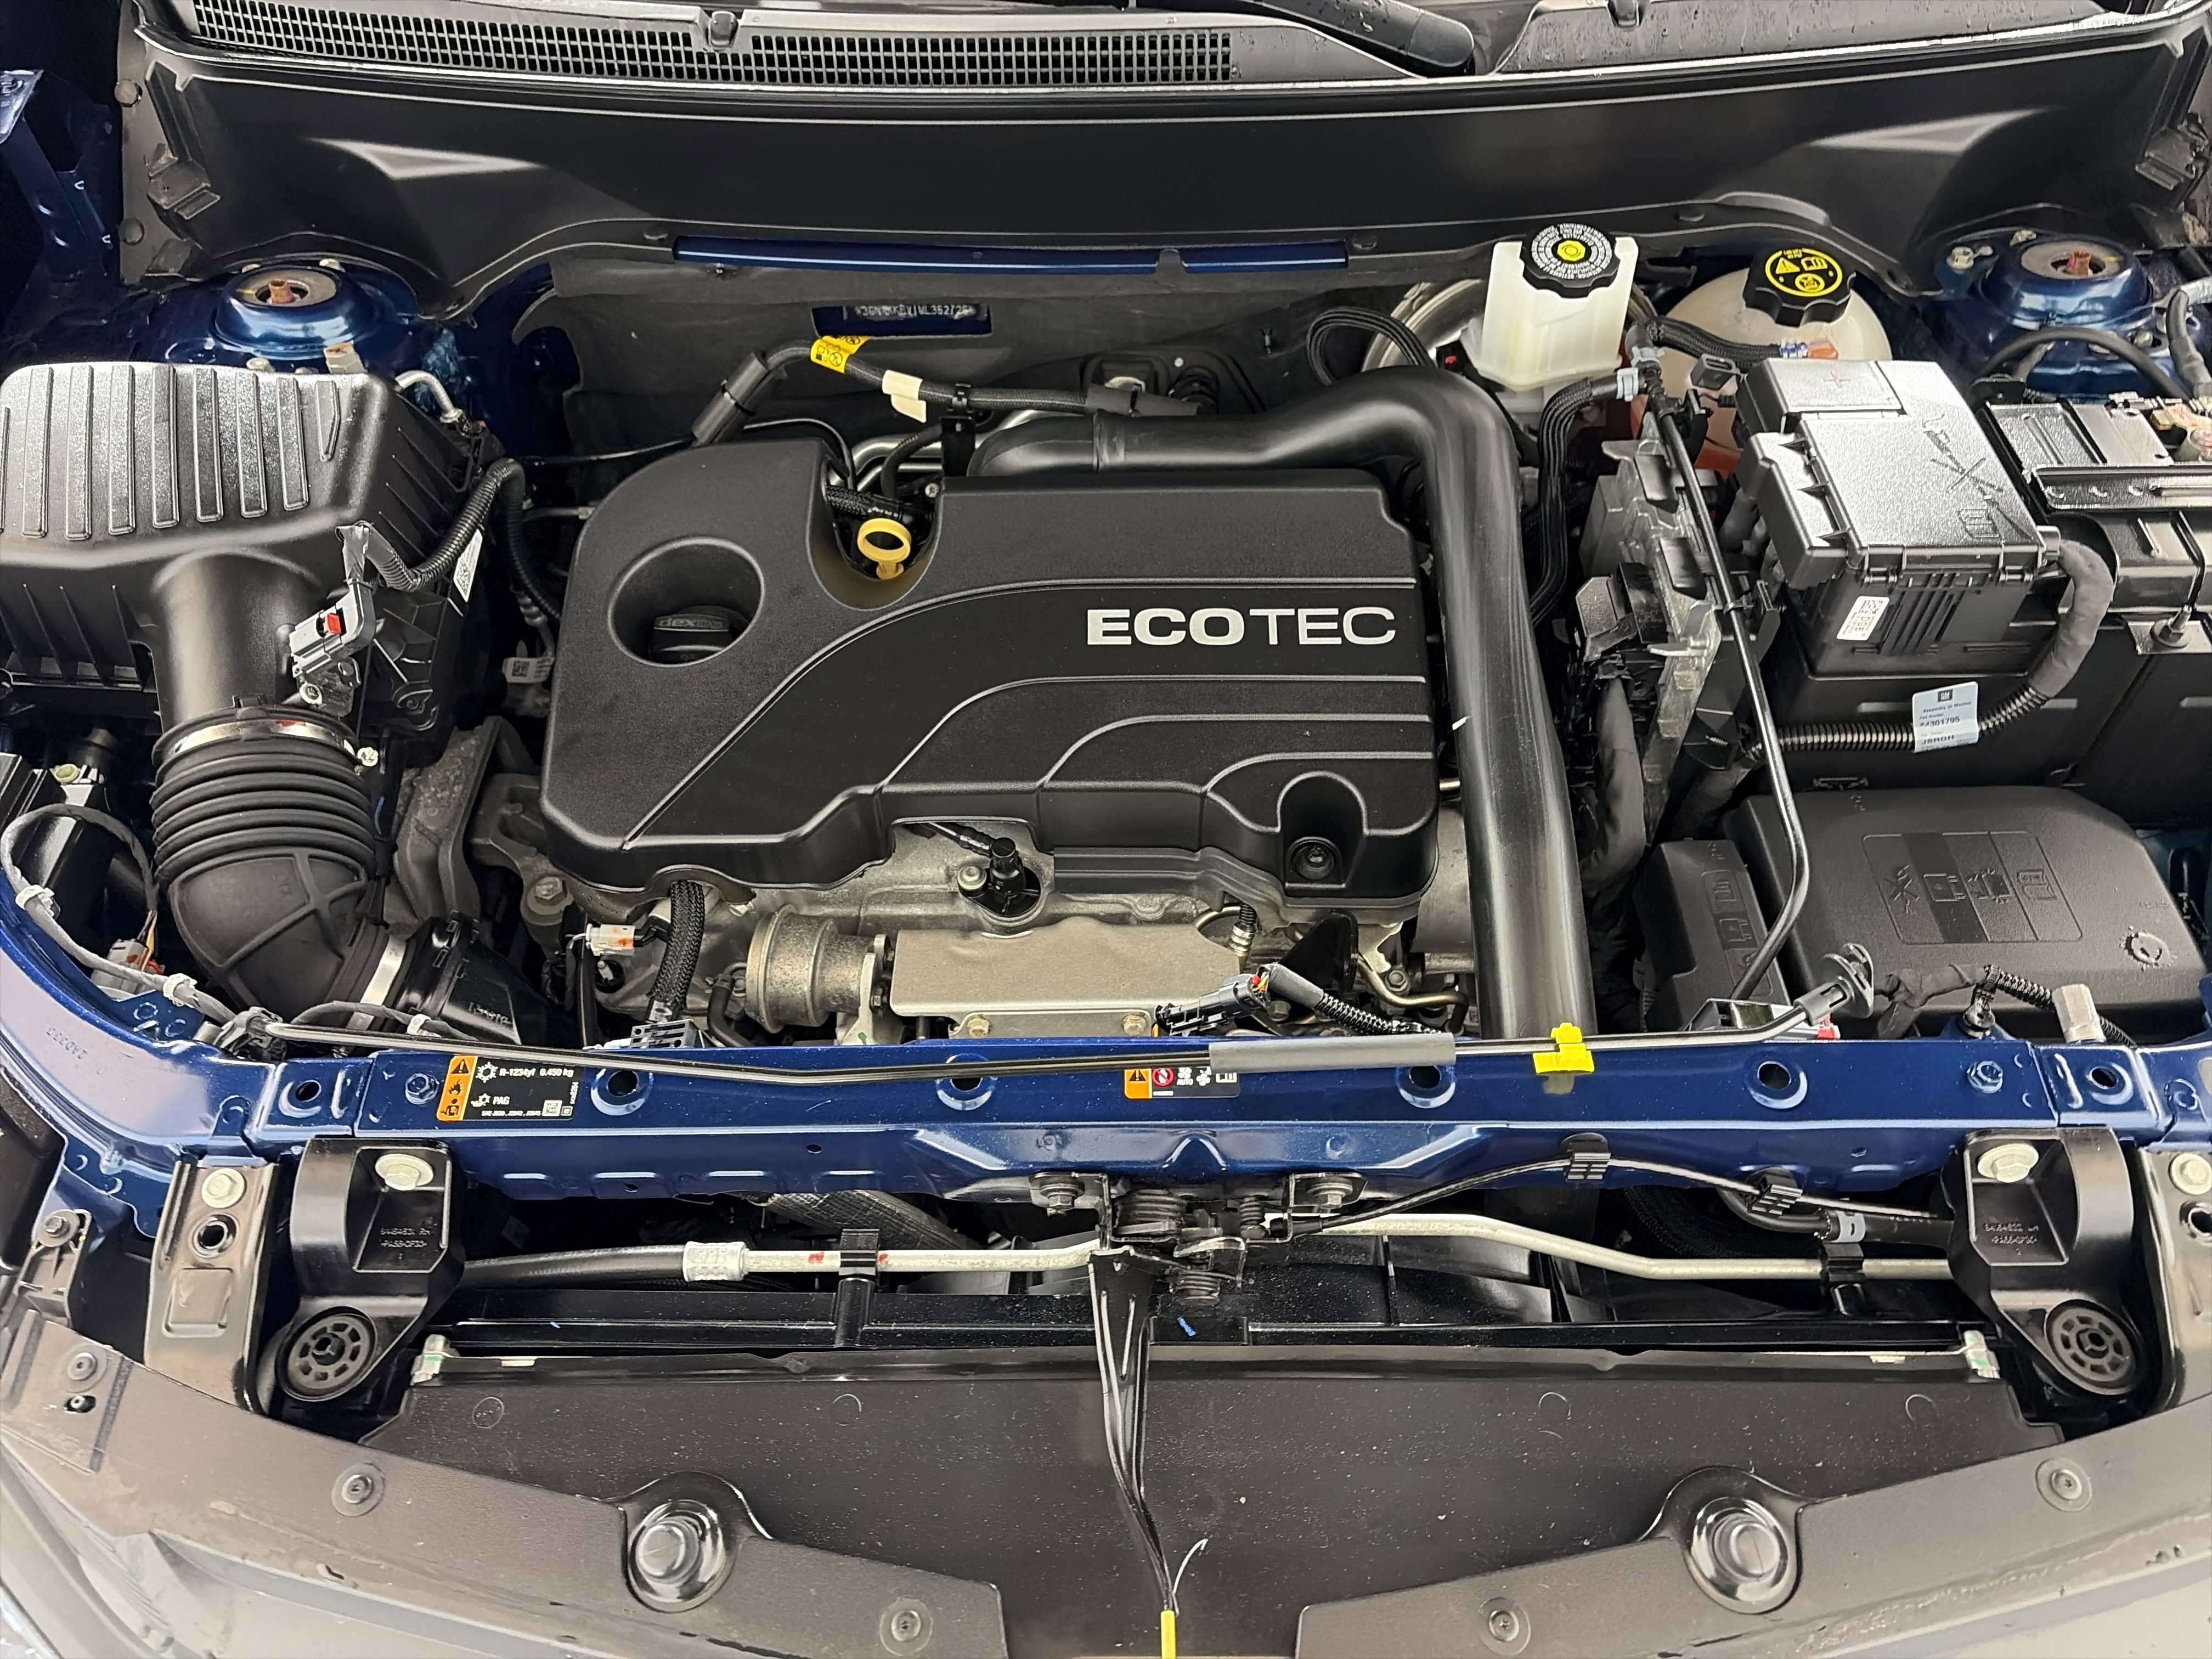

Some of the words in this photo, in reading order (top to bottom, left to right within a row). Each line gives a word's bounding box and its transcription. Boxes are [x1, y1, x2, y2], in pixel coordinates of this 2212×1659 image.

[1087, 607, 1396, 646] ECOTEC
[499, 1068, 536, 1078] R-1234yf
[539, 1068, 562, 1077] 0.450
[562, 1068, 574, 1078] kg
[492, 1096, 511, 1105] PAG
